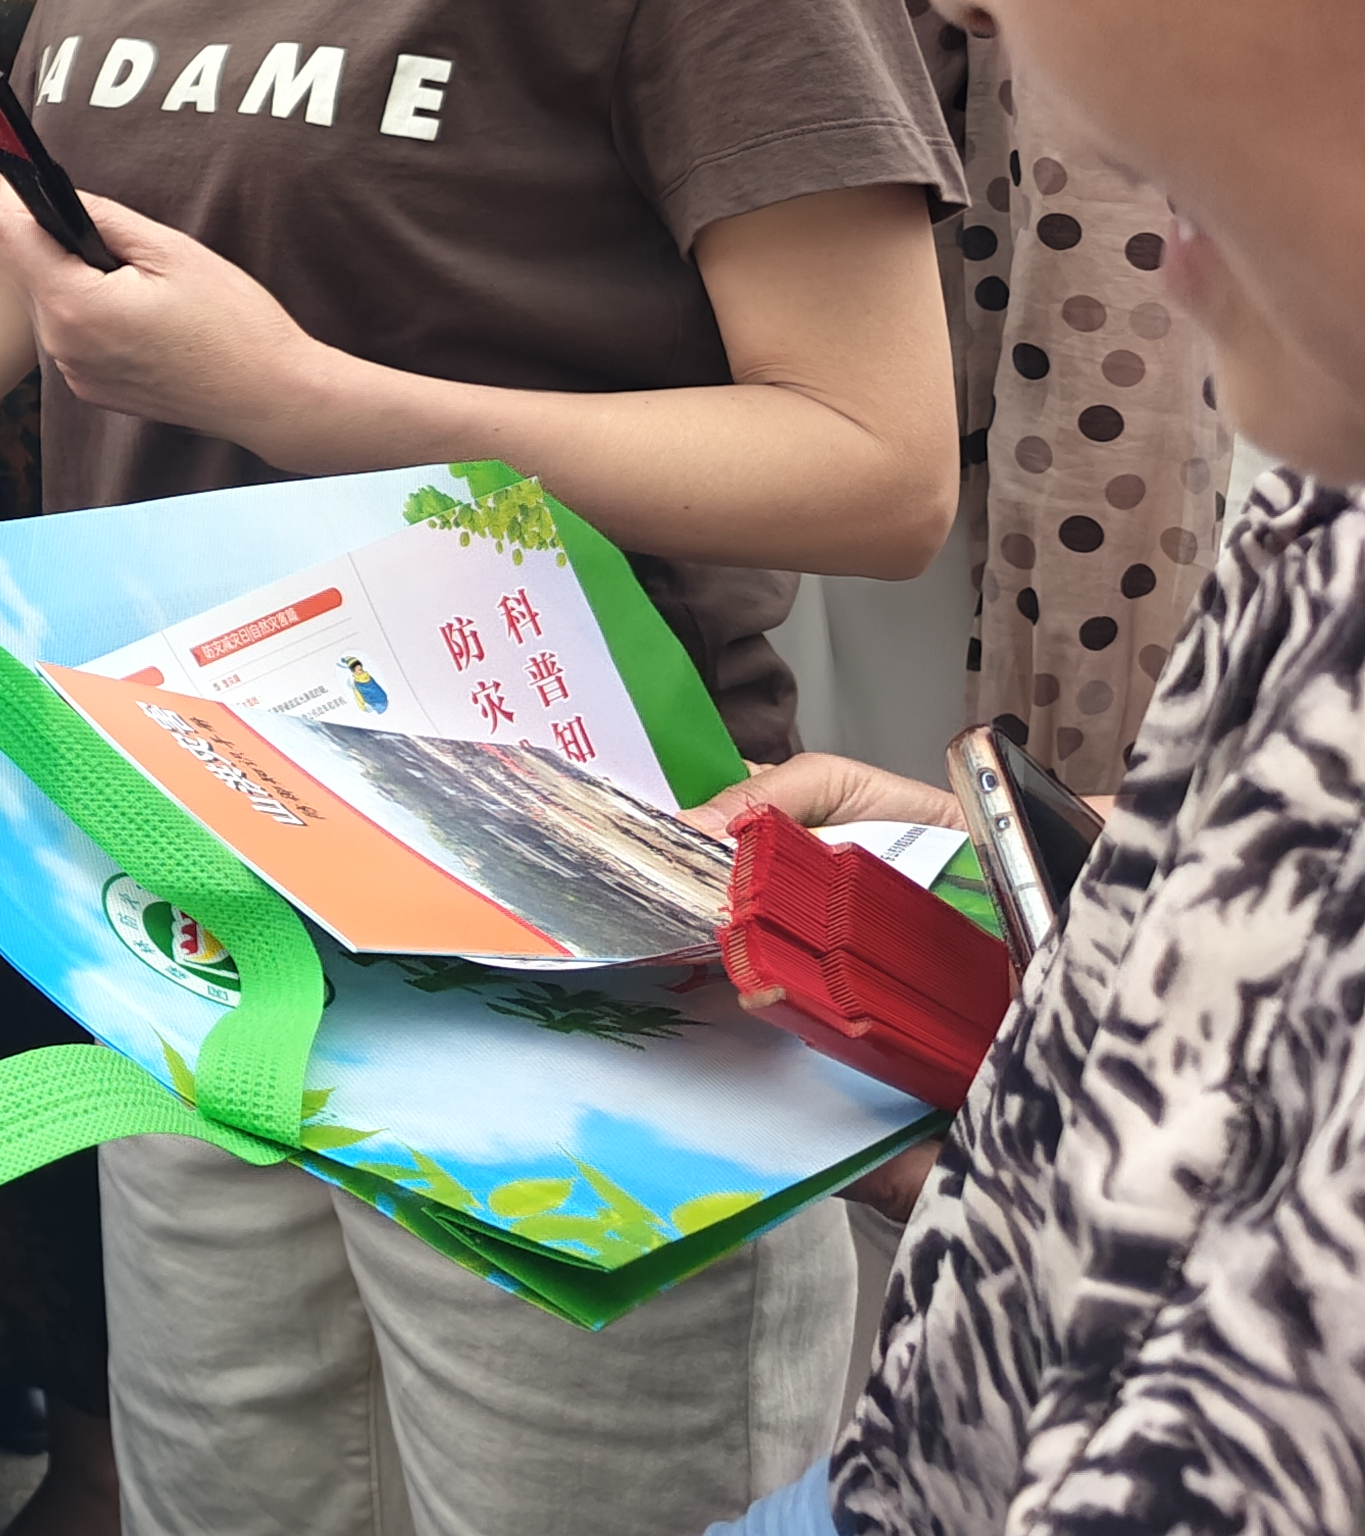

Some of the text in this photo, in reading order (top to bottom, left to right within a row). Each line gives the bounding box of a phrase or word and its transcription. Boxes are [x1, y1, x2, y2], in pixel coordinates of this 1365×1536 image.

[36, 36, 453, 141] ADAME
[438, 615, 531, 748] 防灾
[497, 586, 611, 782] 科普知
[135, 700, 309, 827] 山洪灾害
